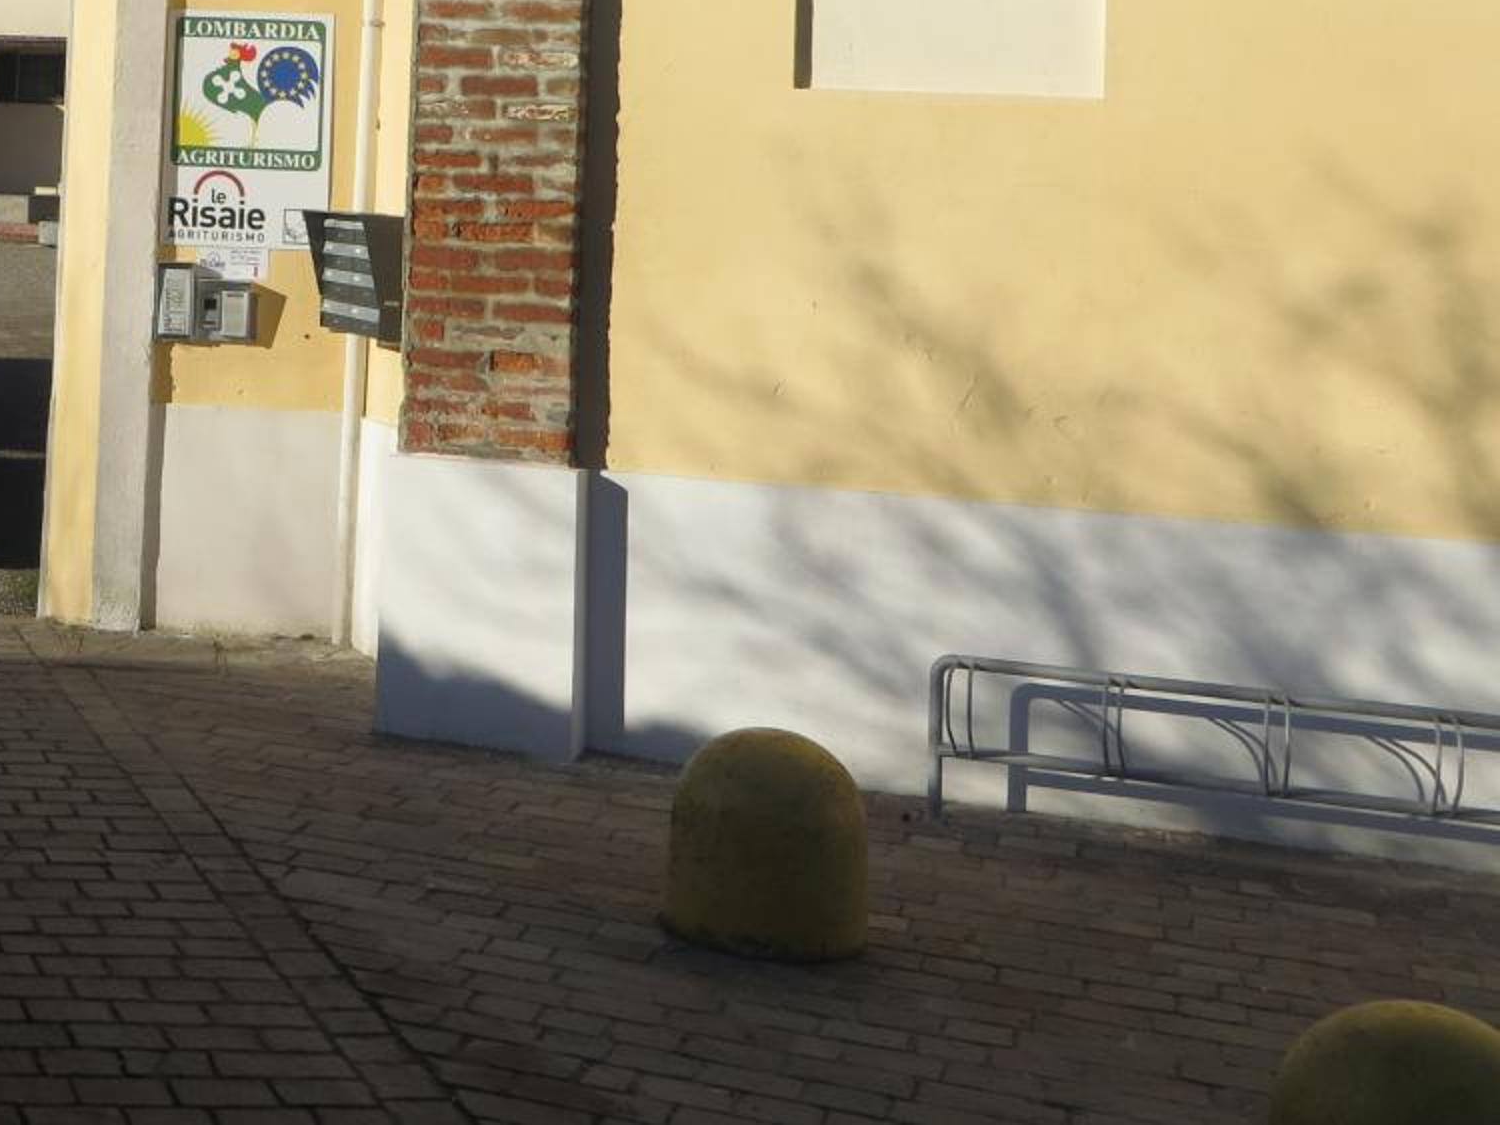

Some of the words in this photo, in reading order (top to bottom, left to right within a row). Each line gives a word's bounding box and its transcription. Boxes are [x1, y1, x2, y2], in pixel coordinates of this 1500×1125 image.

[184, 19, 319, 40] LOMBARDIA
[177, 149, 315, 169] AGRITURISMO
[211, 188, 226, 204] le
[168, 196, 265, 230] Risaie
[167, 228, 265, 242] AGRITURISMO
